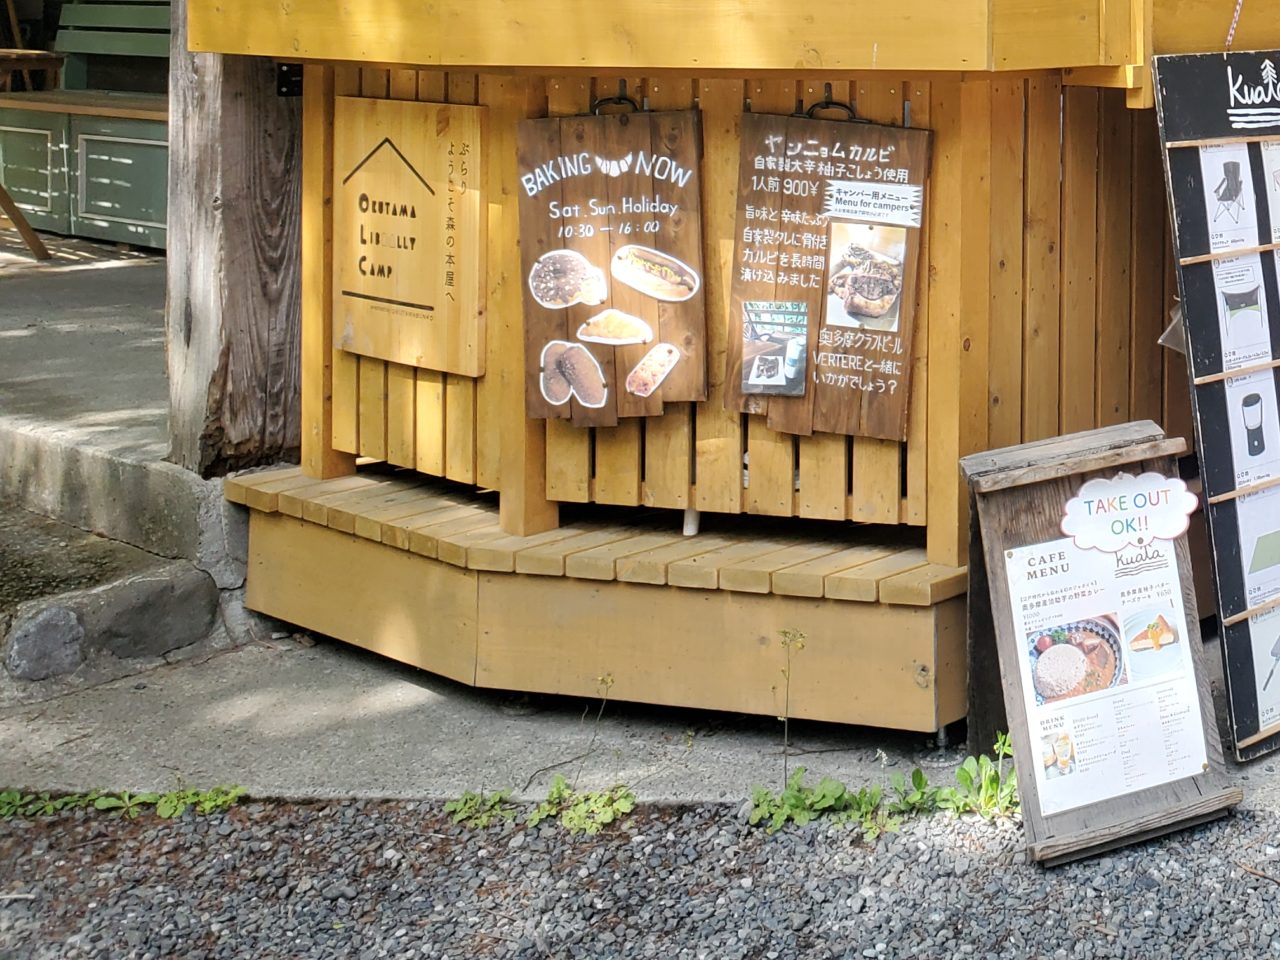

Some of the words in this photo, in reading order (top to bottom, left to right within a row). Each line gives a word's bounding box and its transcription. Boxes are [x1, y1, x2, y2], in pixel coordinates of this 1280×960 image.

[458, 142, 470, 195] ぶらり
[520, 152, 592, 197] BAKING
[635, 151, 692, 188] NOW
[751, 176, 781, 193] 1人前
[622, 194, 678, 216] Holiday
[835, 196, 859, 207] Menu
[860, 198, 872, 208] for
[873, 201, 910, 213] campers
[445, 142, 456, 303] ようこそ森の本屋へ
[558, 224, 595, 238] 10:30
[618, 221, 660, 235] 16:00
[359, 224, 417, 251] LIBLLY
[358, 256, 393, 279] CAMP
[742, 248, 825, 270] カルビを長時間
[740, 266, 821, 289] 漬け込みました
[1084, 494, 1128, 516] TAKE
[1133, 489, 1171, 509] OUT
[1111, 515, 1149, 535] OK!!
[1027, 551, 1066, 567] CAFE
[1026, 563, 1070, 581] MENU
[1040, 715, 1065, 726] DRINK
[1042, 722, 1065, 732] MENU
